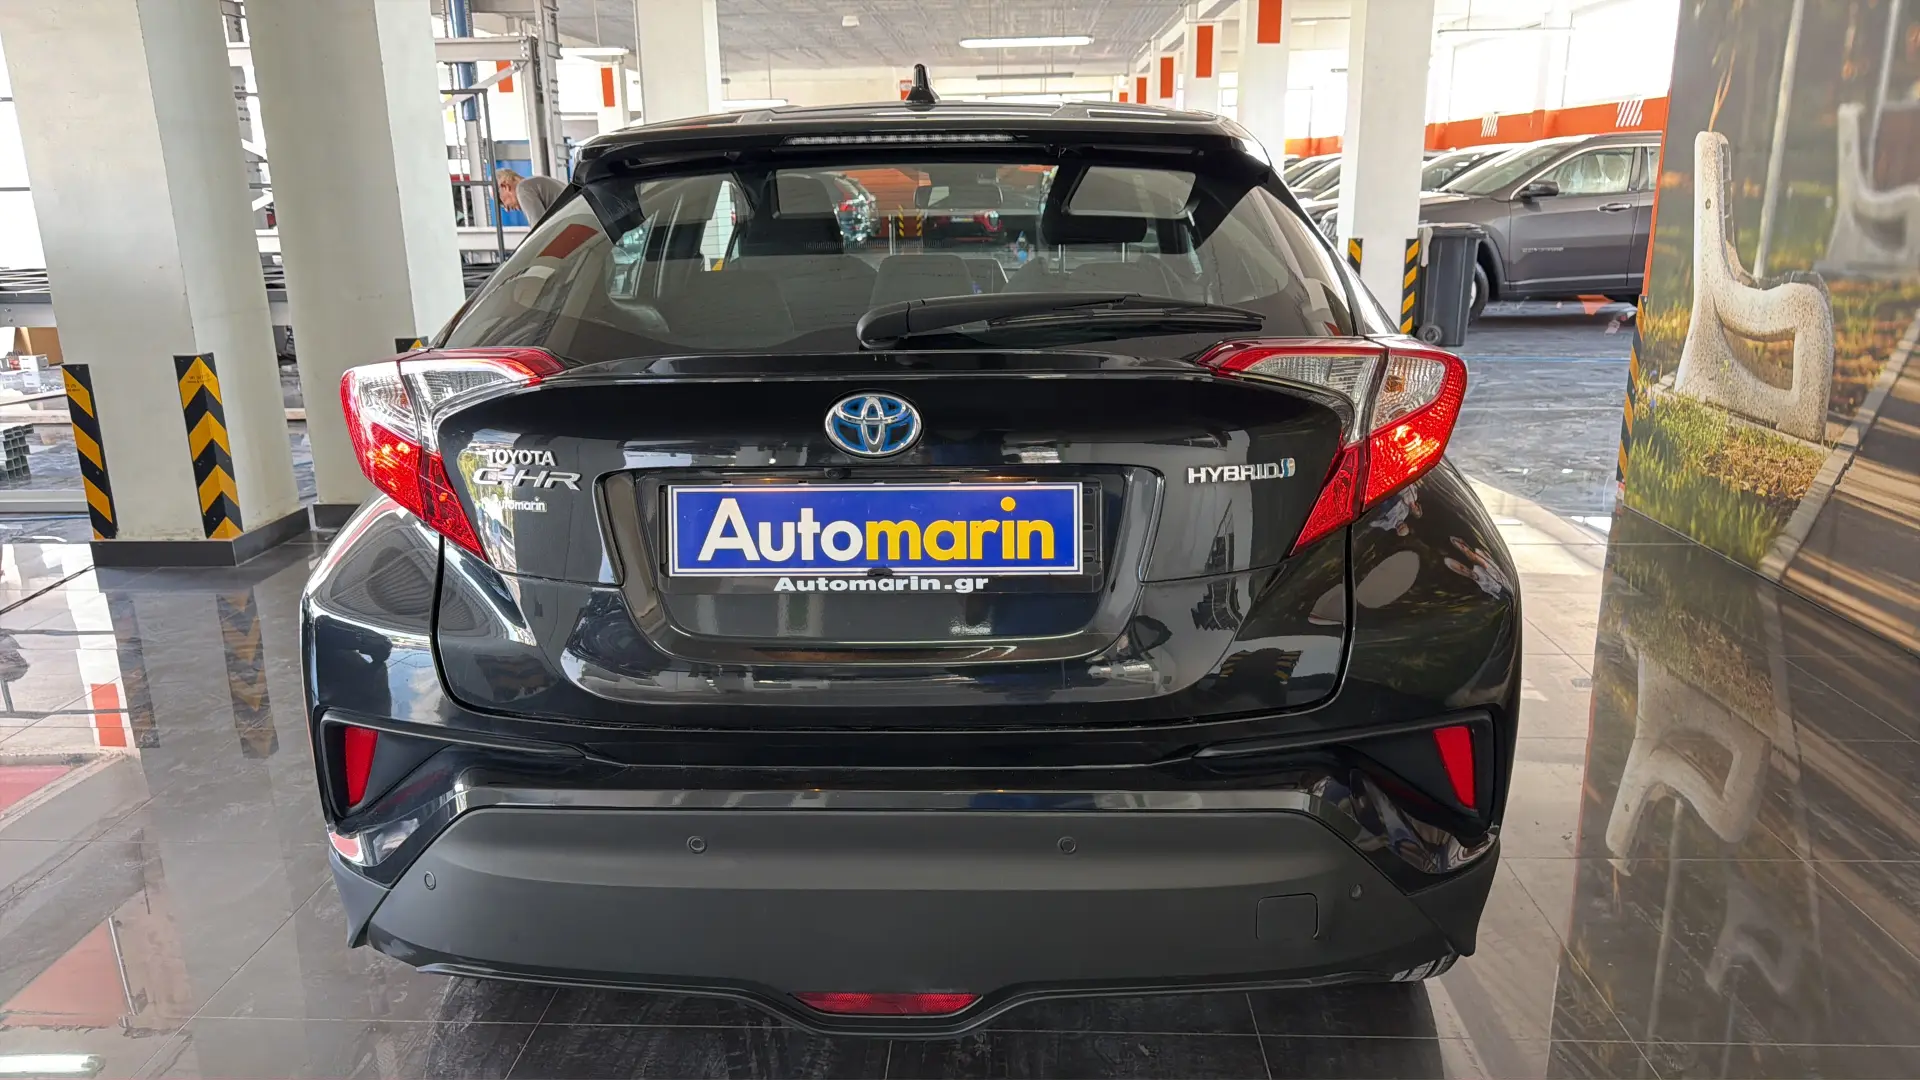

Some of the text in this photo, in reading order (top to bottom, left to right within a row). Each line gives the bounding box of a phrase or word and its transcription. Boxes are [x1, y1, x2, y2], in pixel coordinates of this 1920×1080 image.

[486, 449, 556, 466] TOYOTA
[473, 467, 581, 491] C-HR
[1187, 462, 1280, 484] HYBRID
[489, 496, 546, 511] utomarin
[697, 496, 1055, 562] Automarin
[773, 575, 989, 593] Automarin.gr
